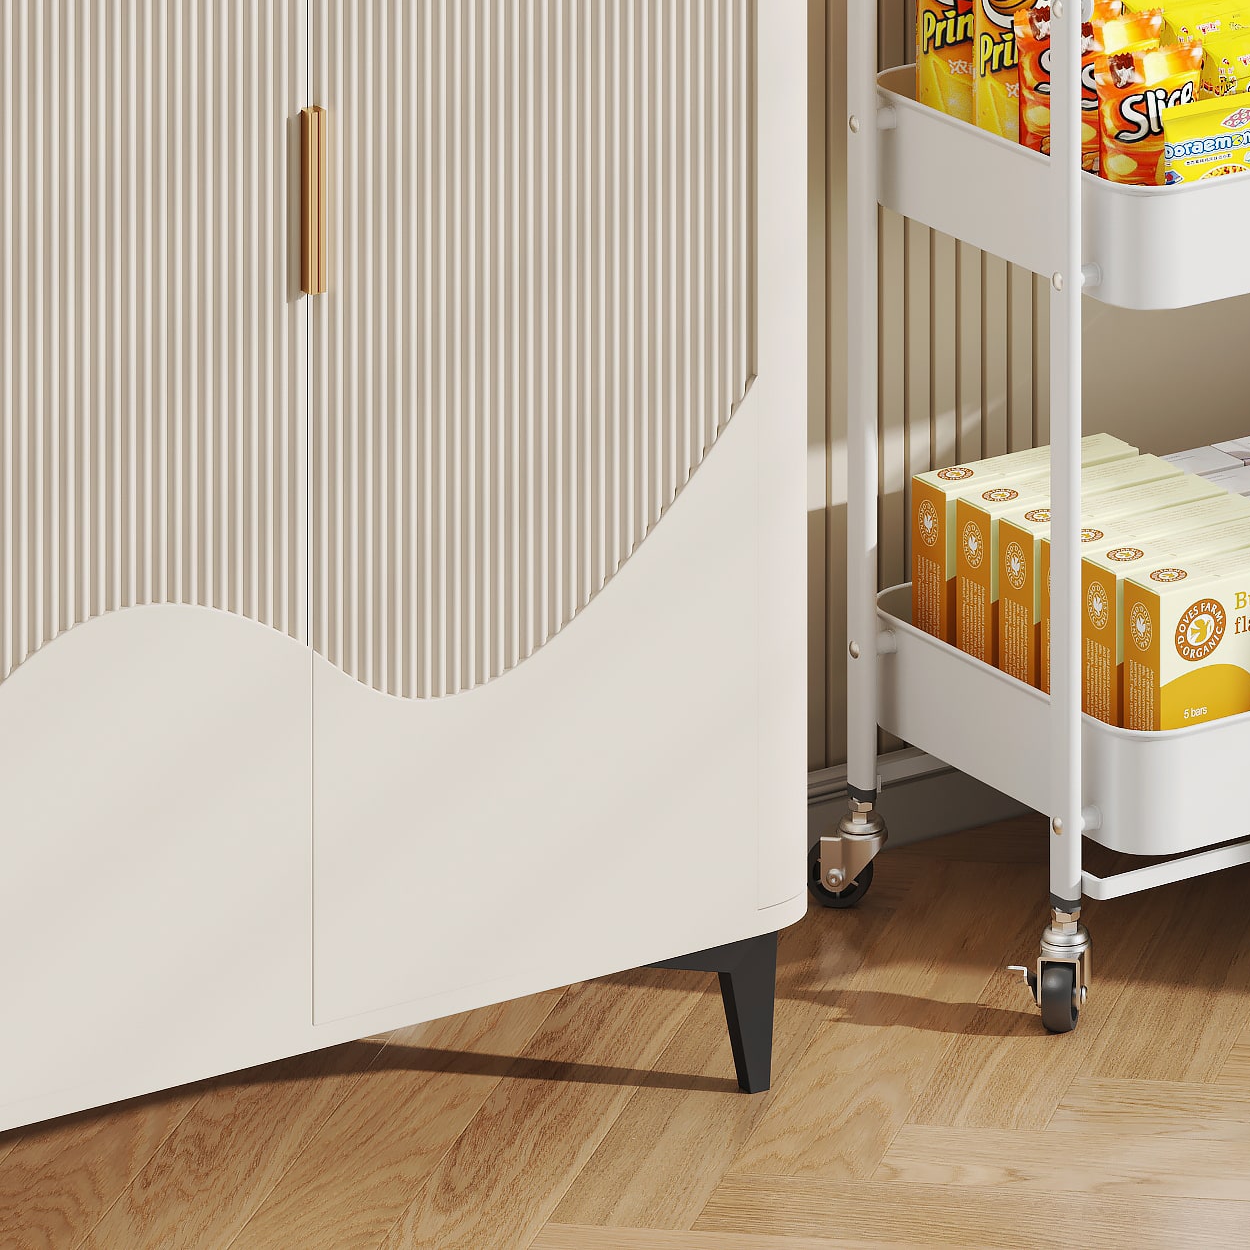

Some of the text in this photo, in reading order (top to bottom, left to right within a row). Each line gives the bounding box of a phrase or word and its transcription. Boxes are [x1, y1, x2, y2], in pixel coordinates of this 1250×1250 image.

[1182, 626, 1223, 658] ORGANIC
[1183, 706, 1208, 719] 5 bars
